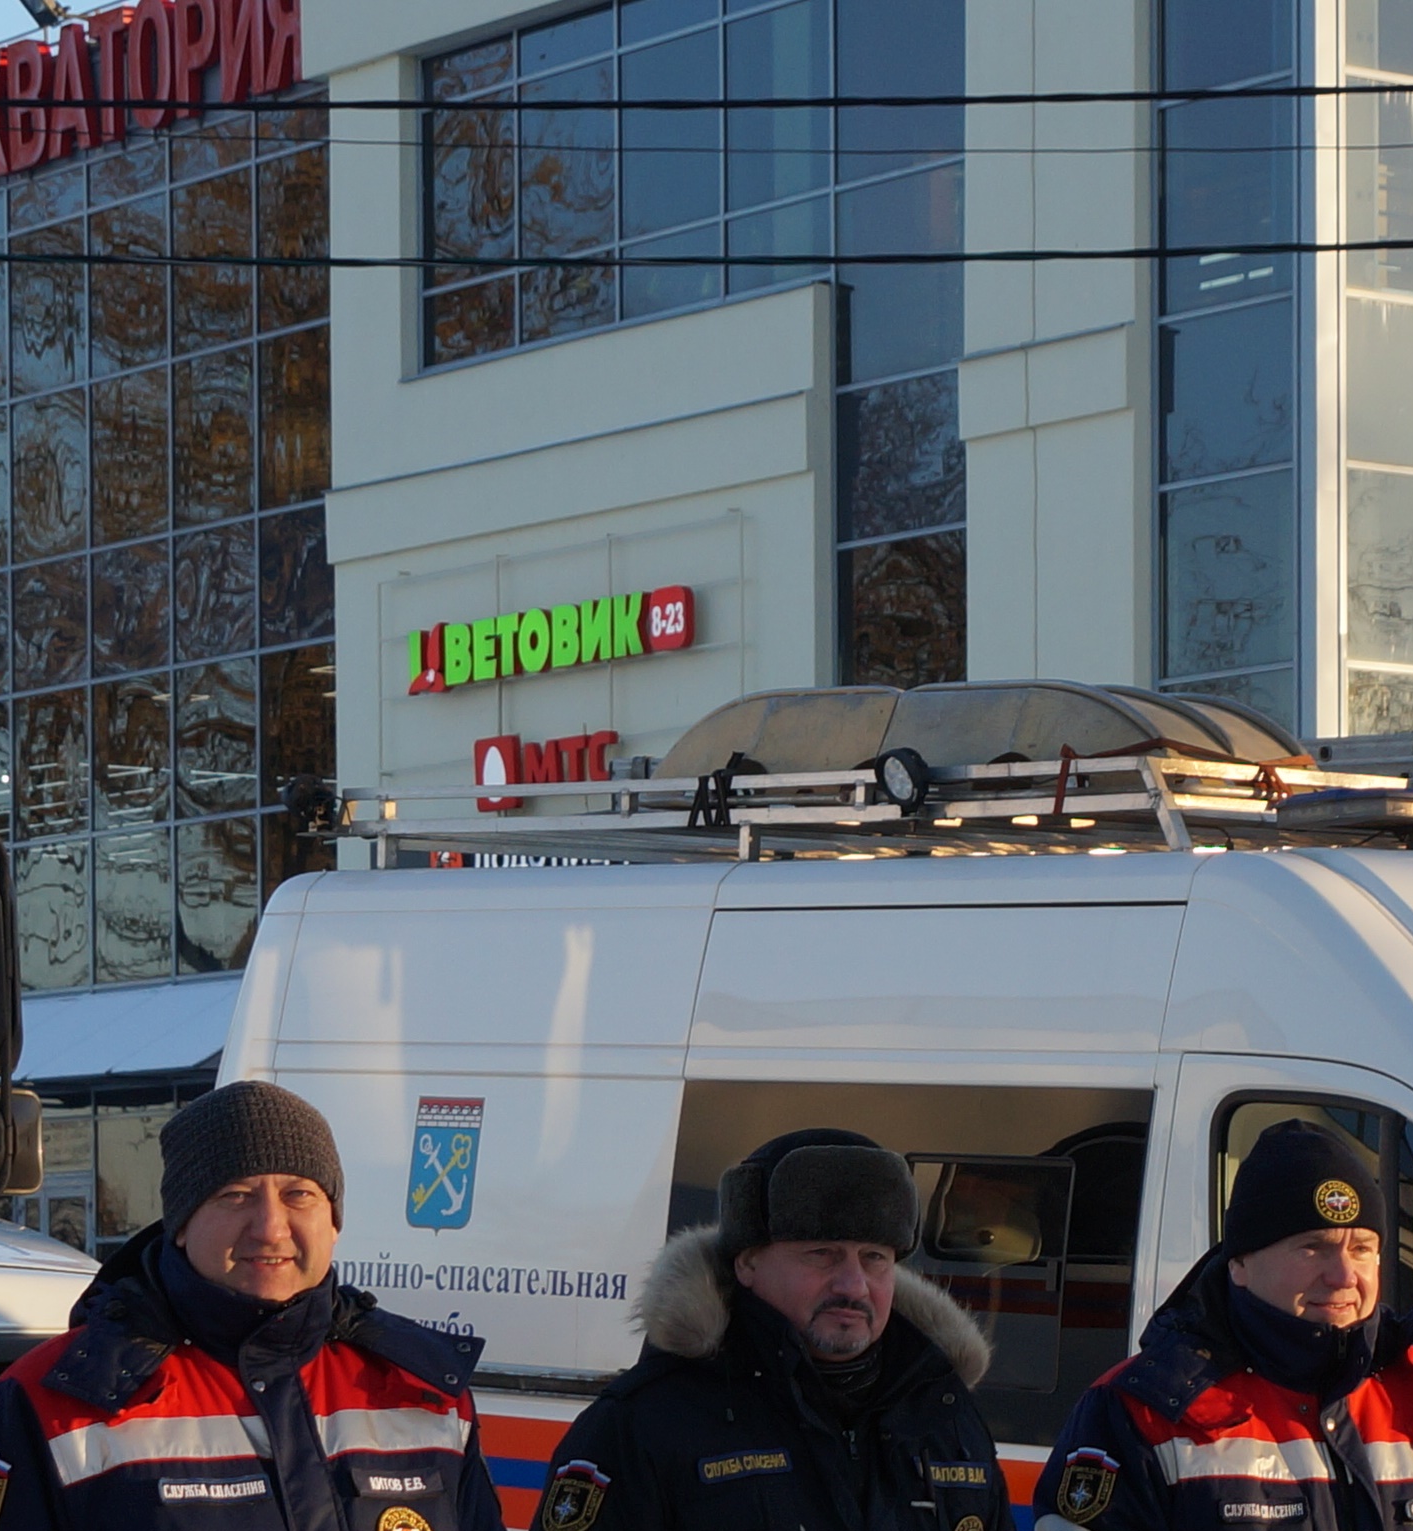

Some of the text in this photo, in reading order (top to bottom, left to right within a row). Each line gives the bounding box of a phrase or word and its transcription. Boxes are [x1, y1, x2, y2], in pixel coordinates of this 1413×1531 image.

[652, 601, 684, 637] 8-23
[523, 731, 618, 783] МТС
[331, 1251, 628, 1301] рийно-спасательная
[163, 1479, 267, 1499] СЛУЖБА СПАСЕНИЯ
[930, 1466, 966, 1482] ТАПОВ
